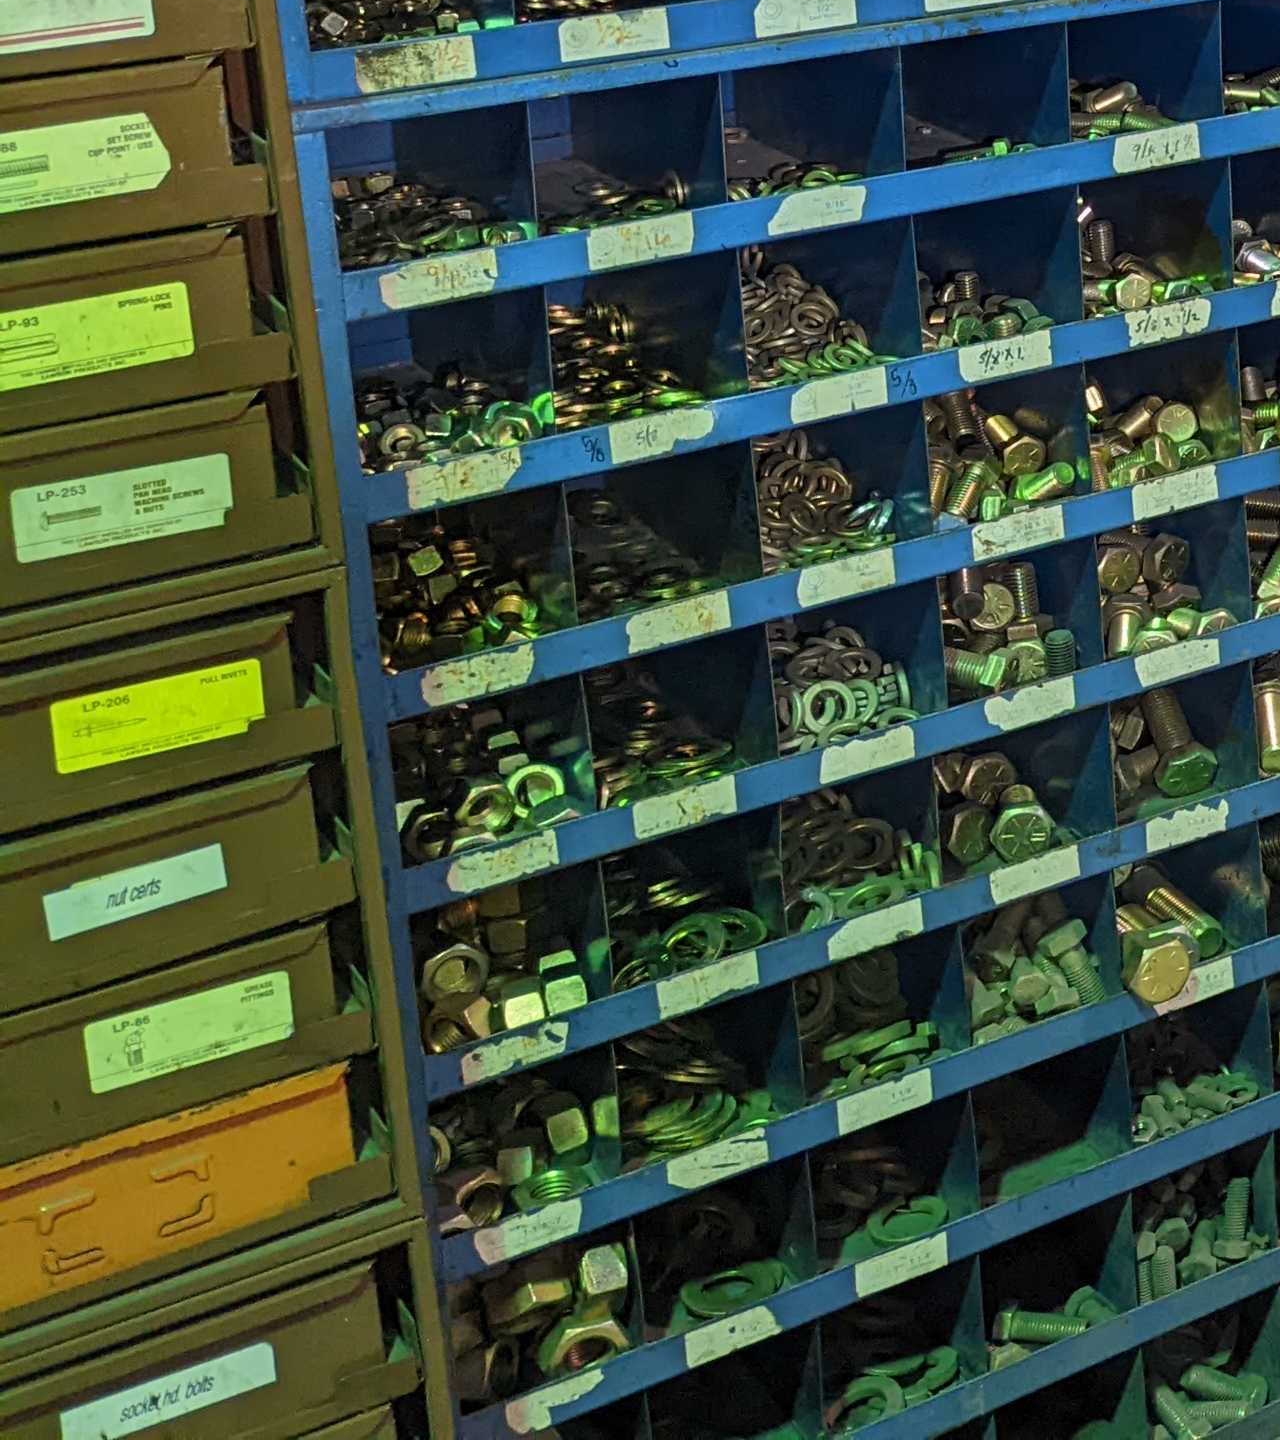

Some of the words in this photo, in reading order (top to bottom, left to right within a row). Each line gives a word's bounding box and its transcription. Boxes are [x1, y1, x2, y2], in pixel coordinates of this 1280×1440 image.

[106, 135, 122, 146] SET
[124, 131, 152, 144] SCREW
[106, 144, 131, 156] POINT
[36, 484, 87, 503] LP-253
[132, 478, 167, 491] SLOTTED
[82, 695, 130, 713] LP-206
[106, 886, 128, 910] nut
[129, 877, 162, 903] certs
[185, 1375, 215, 1399] bolts
